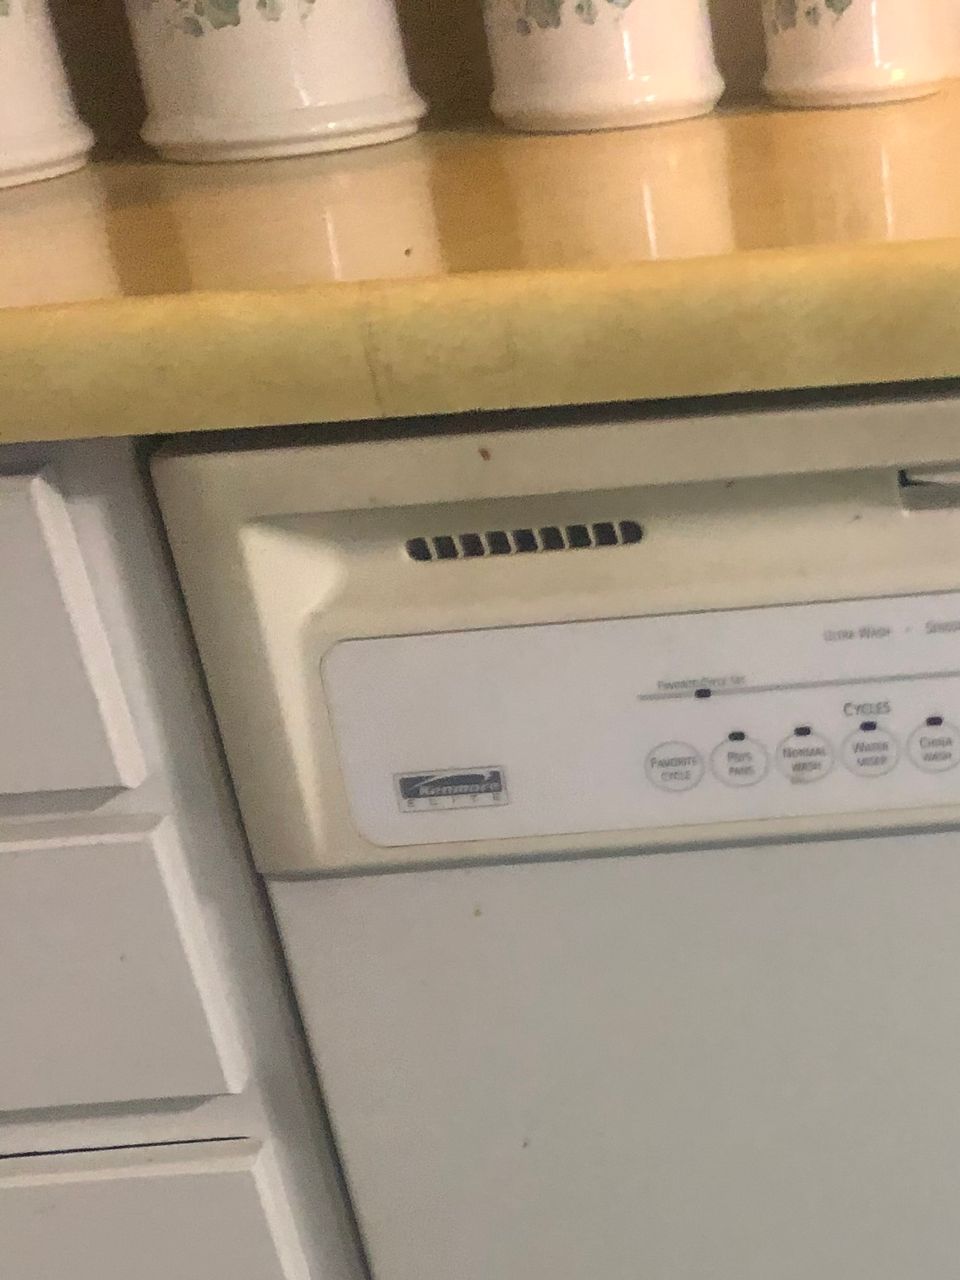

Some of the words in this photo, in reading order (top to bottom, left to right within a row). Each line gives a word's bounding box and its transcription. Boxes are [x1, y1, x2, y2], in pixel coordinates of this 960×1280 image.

[843, 701, 892, 717] CYCLES
[782, 746, 827, 759] NORMAL
[650, 756, 698, 768] FAVORITE
[418, 782, 502, 796] Kenmore
